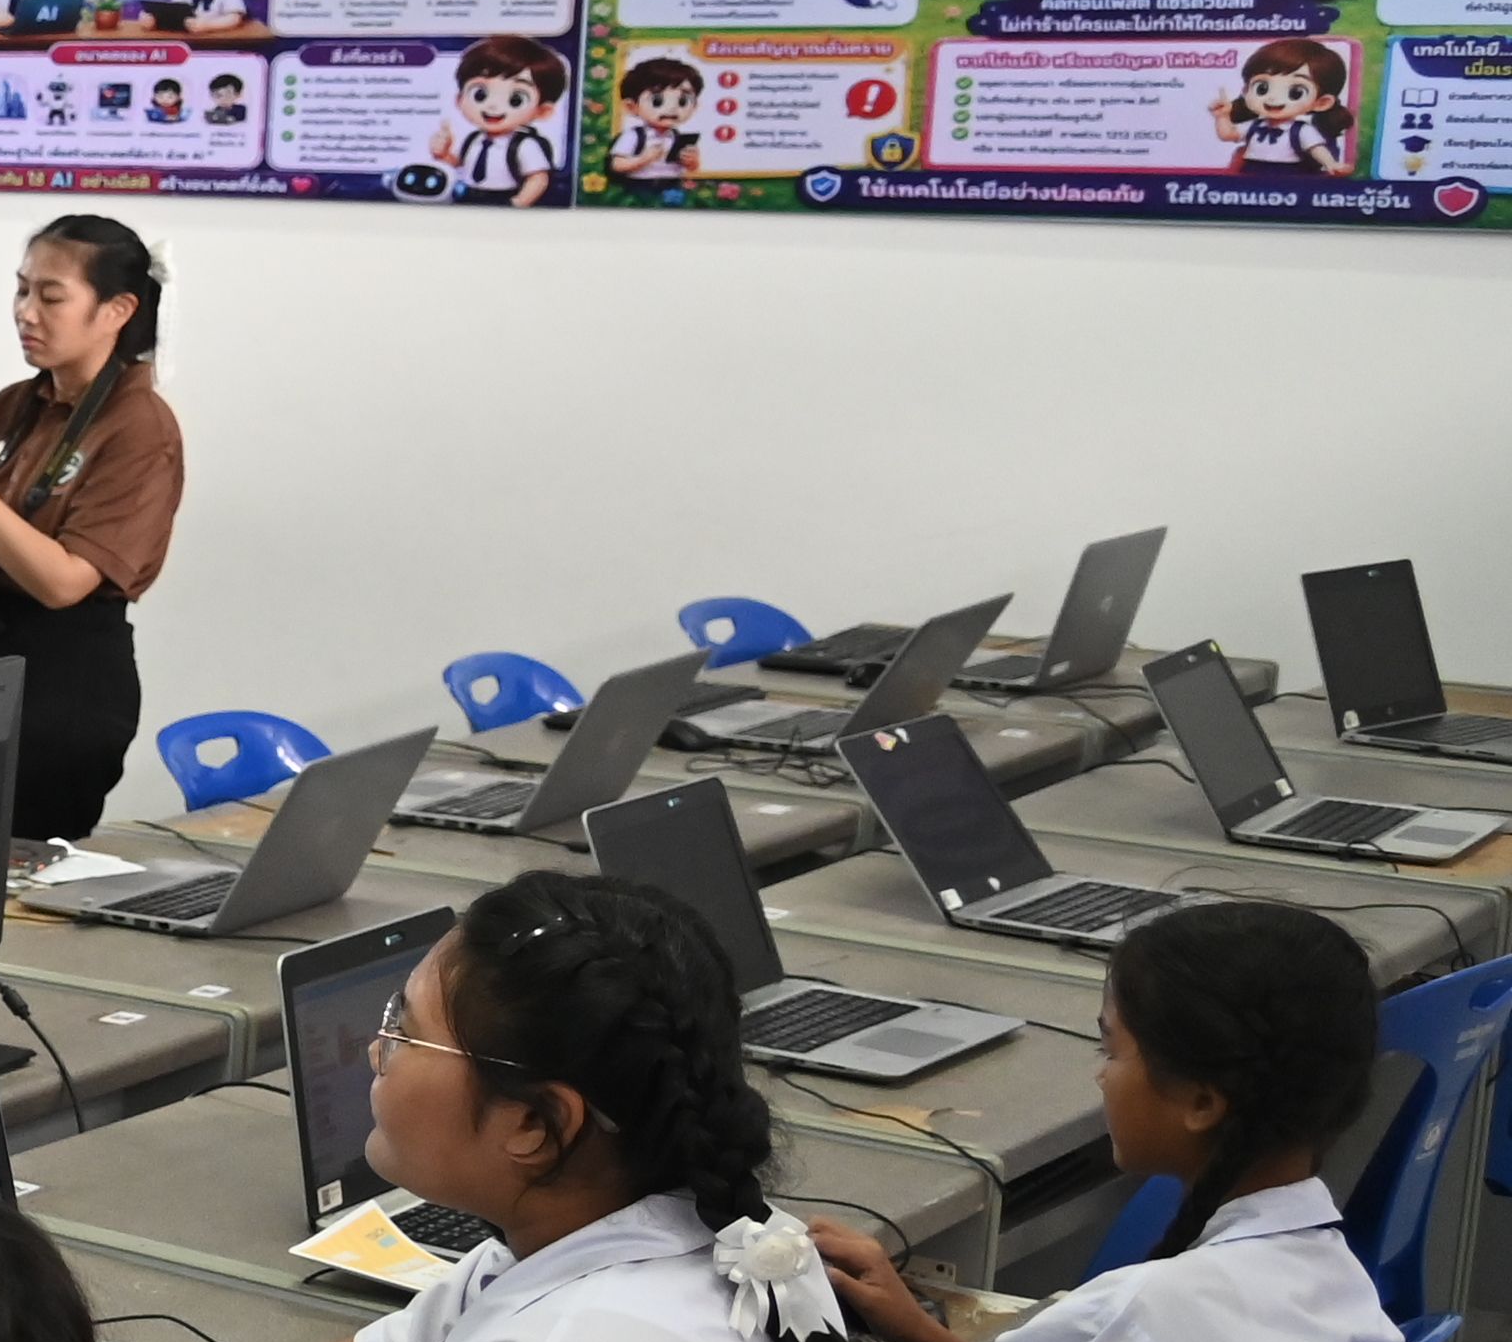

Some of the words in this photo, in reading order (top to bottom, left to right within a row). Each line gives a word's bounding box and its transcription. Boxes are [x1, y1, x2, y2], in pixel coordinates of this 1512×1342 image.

[36, 6, 59, 23] AI
[151, 49, 168, 60] AI
[50, 172, 74, 188] AI
[858, 175, 1146, 205] ใช้เทคโนโลยีอย่างปลอดภัย
[1165, 181, 1299, 208] ใส่ใจตนเอง
[1312, 184, 1412, 215] และผู้อื่น
